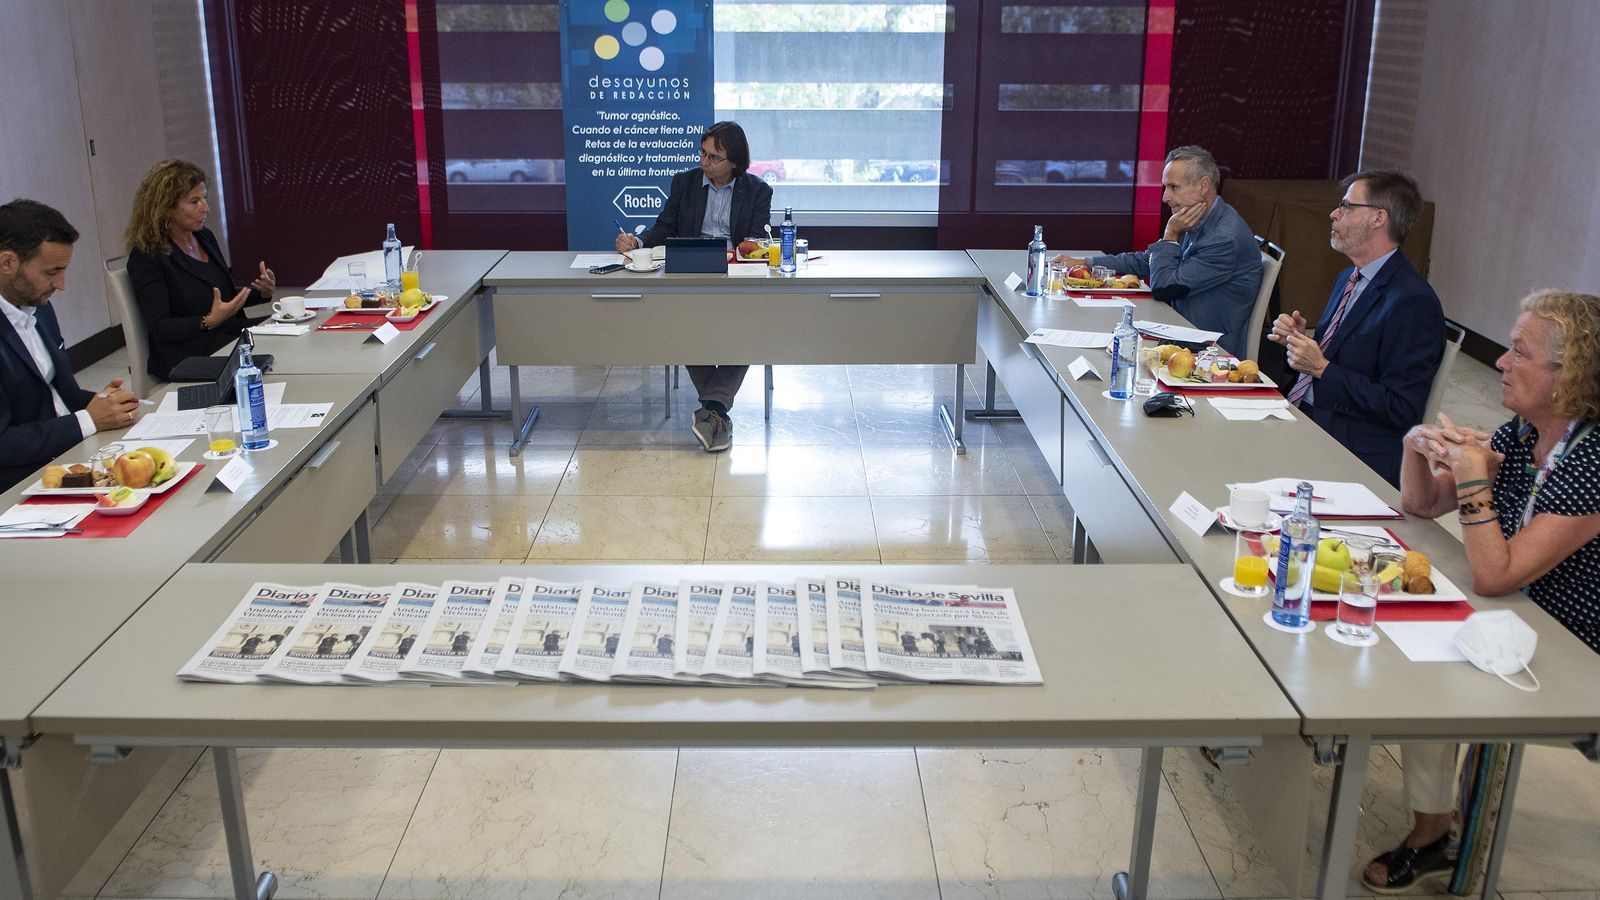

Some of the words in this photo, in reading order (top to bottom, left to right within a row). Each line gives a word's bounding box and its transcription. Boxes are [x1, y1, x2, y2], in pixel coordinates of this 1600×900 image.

[589, 75, 689, 90] desayunos
[590, 91, 604, 99] DE
[613, 89, 690, 100] REDACCIÓN
[596, 111, 629, 120] "Tumor
[631, 110, 680, 122] agnóstico.
[572, 125, 611, 135] Cuando
[613, 125, 622, 134] el
[624, 125, 658, 135] cáncer
[660, 125, 684, 134] tiene
[585, 139, 611, 149] Retos
[613, 139, 626, 149] de
[628, 139, 637, 149] la
[640, 139, 694, 149] evaluación
[578, 153, 636, 164] diagnóstico
[638, 155, 644, 164] y
[645, 153, 701, 163] tratamiento
[591, 169, 605, 177] en
[606, 168, 615, 177] la
[617, 167, 647, 177] última
[624, 194, 662, 208] Roche
[256, 588, 310, 600] Diario
[327, 588, 382, 600] Diario
[872, 585, 922, 598] Diario
[948, 592, 1006, 602] Sevilla
